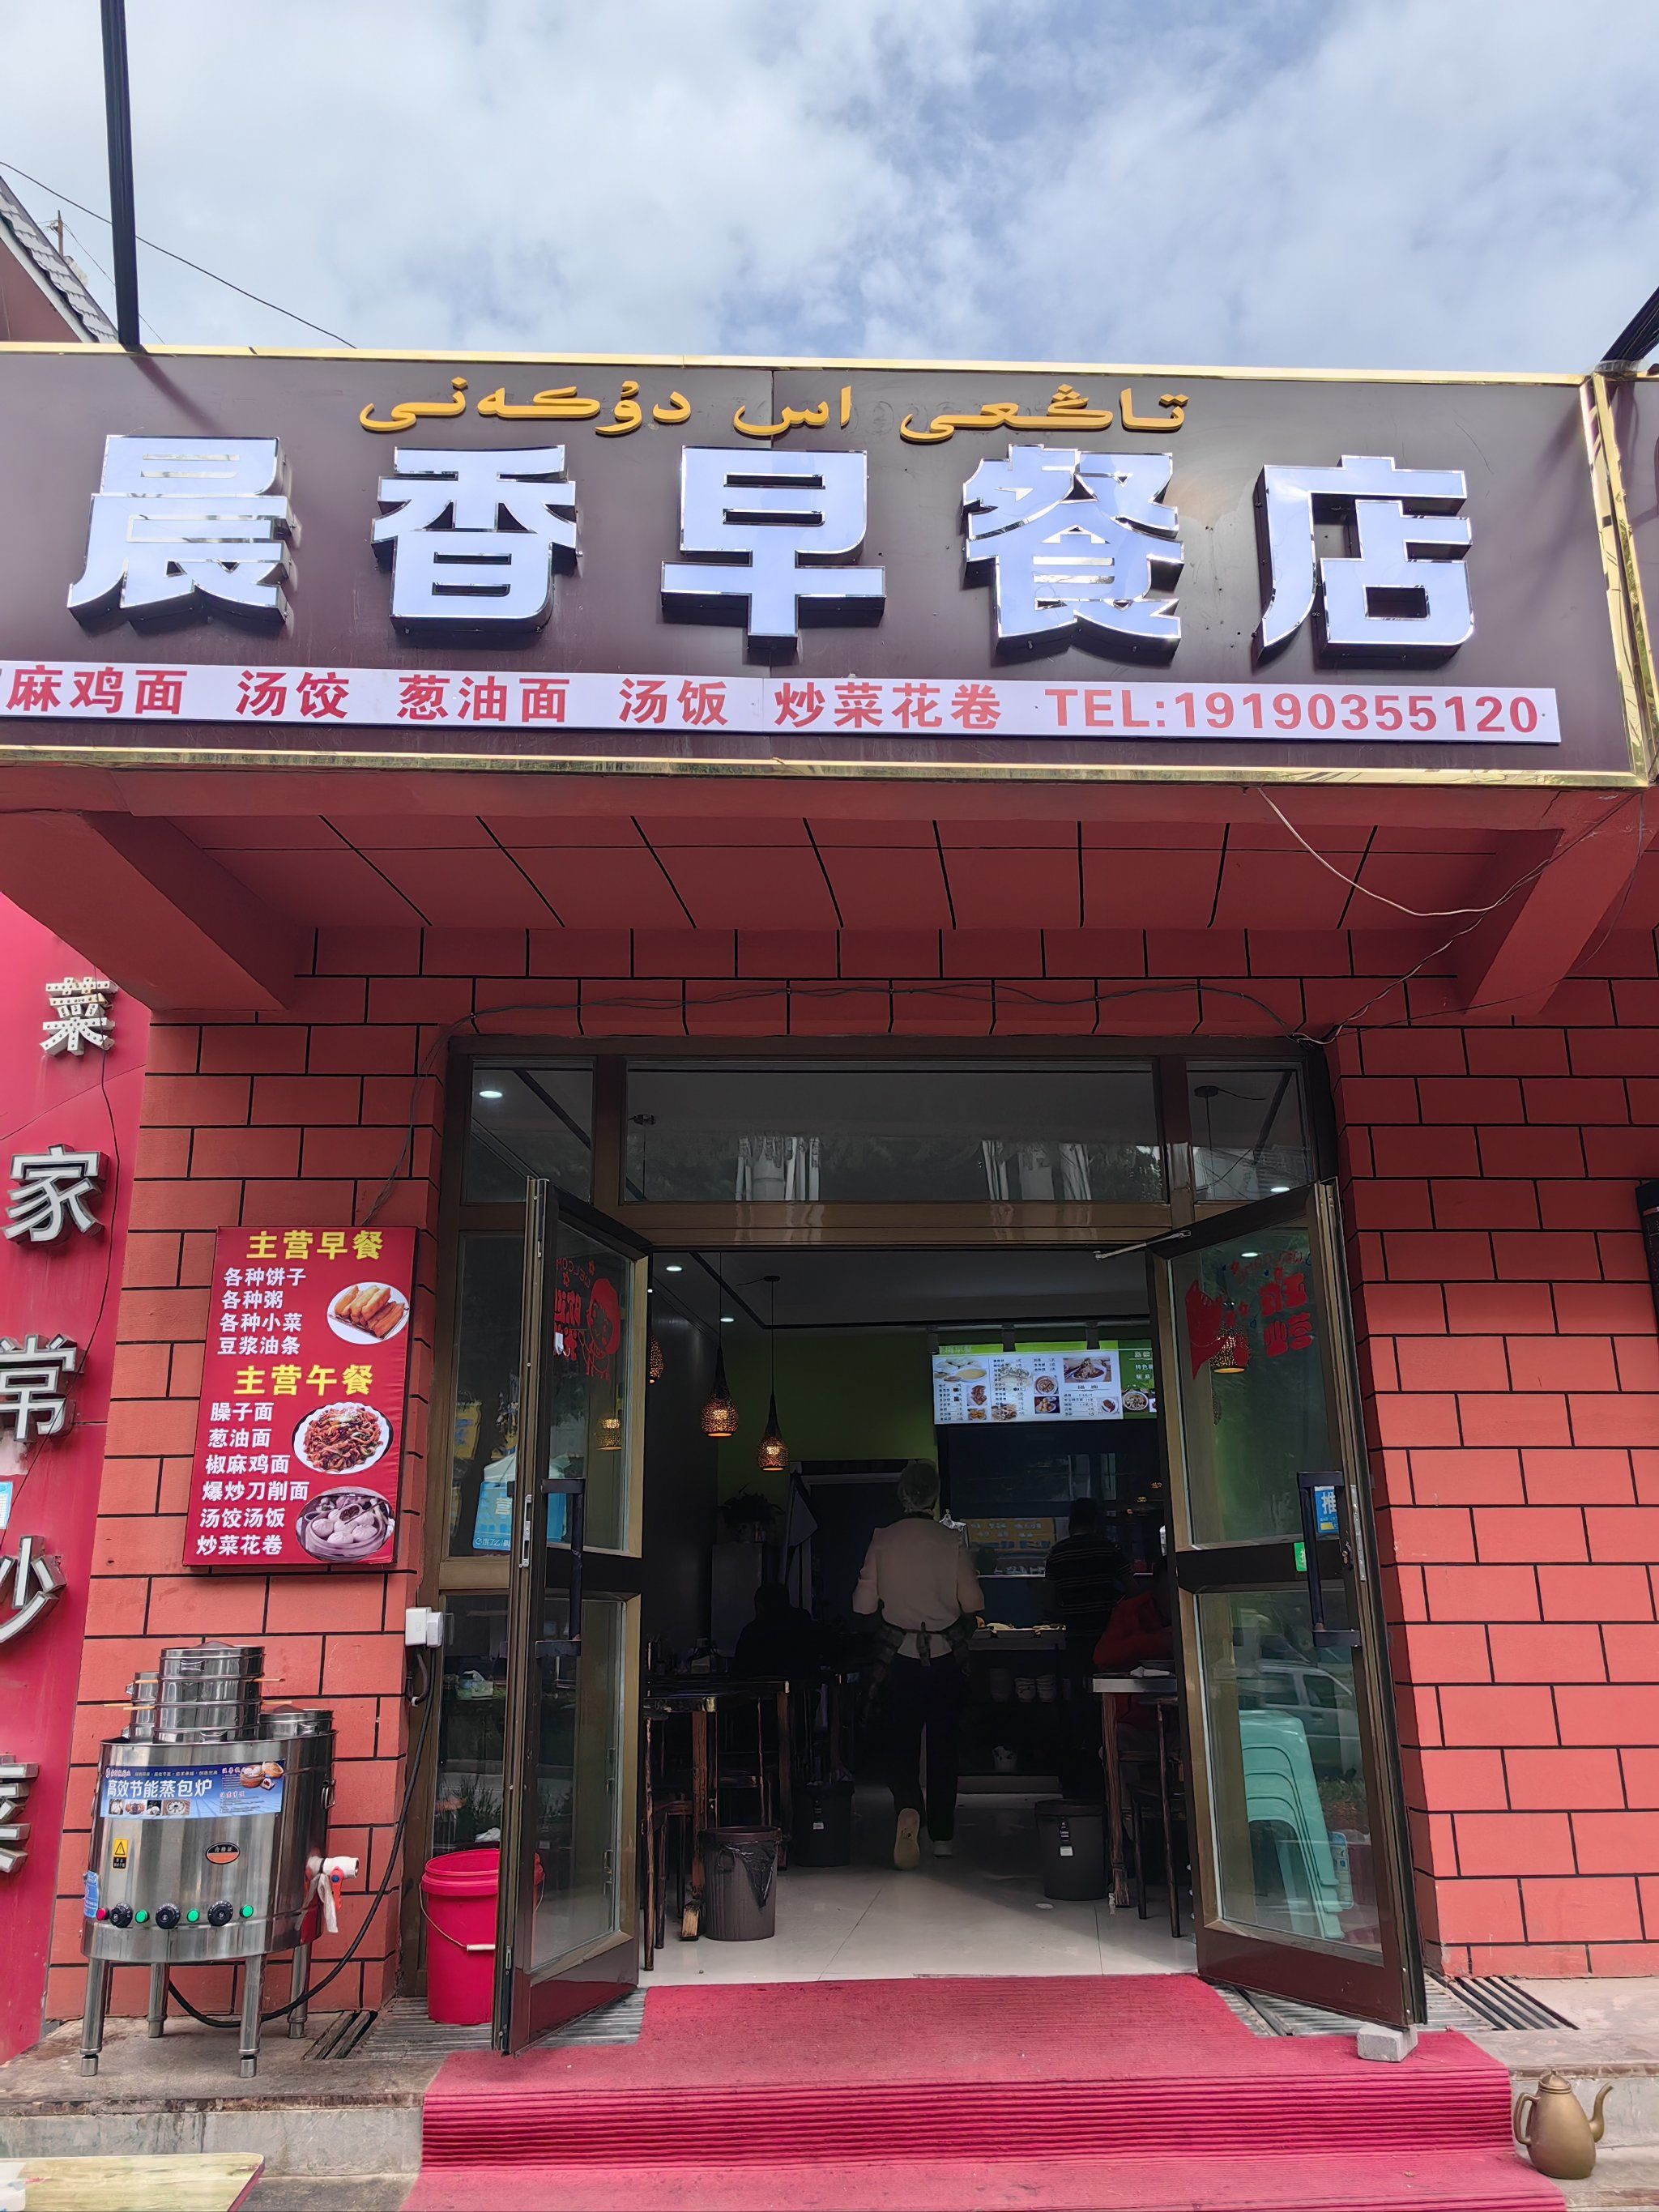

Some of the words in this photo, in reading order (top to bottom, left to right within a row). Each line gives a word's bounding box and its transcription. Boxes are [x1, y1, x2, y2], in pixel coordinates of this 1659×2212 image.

[67, 435, 1474, 650] 晨香早餐店
[0, 663, 188, 715] 麻鸡面
[236, 671, 350, 718] 汤饺
[397, 675, 569, 723] 葱油面
[618, 677, 727, 726] 汤饭
[774, 682, 1001, 731] 炒菜花卷
[1044, 688, 1538, 733] TEL:19190355120
[40, 977, 115, 1055] 菜
[246, 1230, 384, 1261] 主营早餐
[224, 1268, 307, 1287] 各种饼子
[222, 1290, 284, 1310] 各种粥
[220, 1313, 303, 1332] 各种小菜
[217, 1336, 301, 1356] 豆浆油条
[233, 1364, 374, 1396] 主营午餐
[210, 1401, 274, 1422] 臊子面
[208, 1428, 271, 1448] 葱油面
[205, 1454, 291, 1475] 椒麻鸡面
[202, 1481, 309, 1502] 爆炒刀削面
[199, 1507, 285, 1528] 汤饺汤饭
[197, 1535, 283, 1557] 炒菜花卷
[107, 1779, 213, 1798] 高效节能蒸包炉
